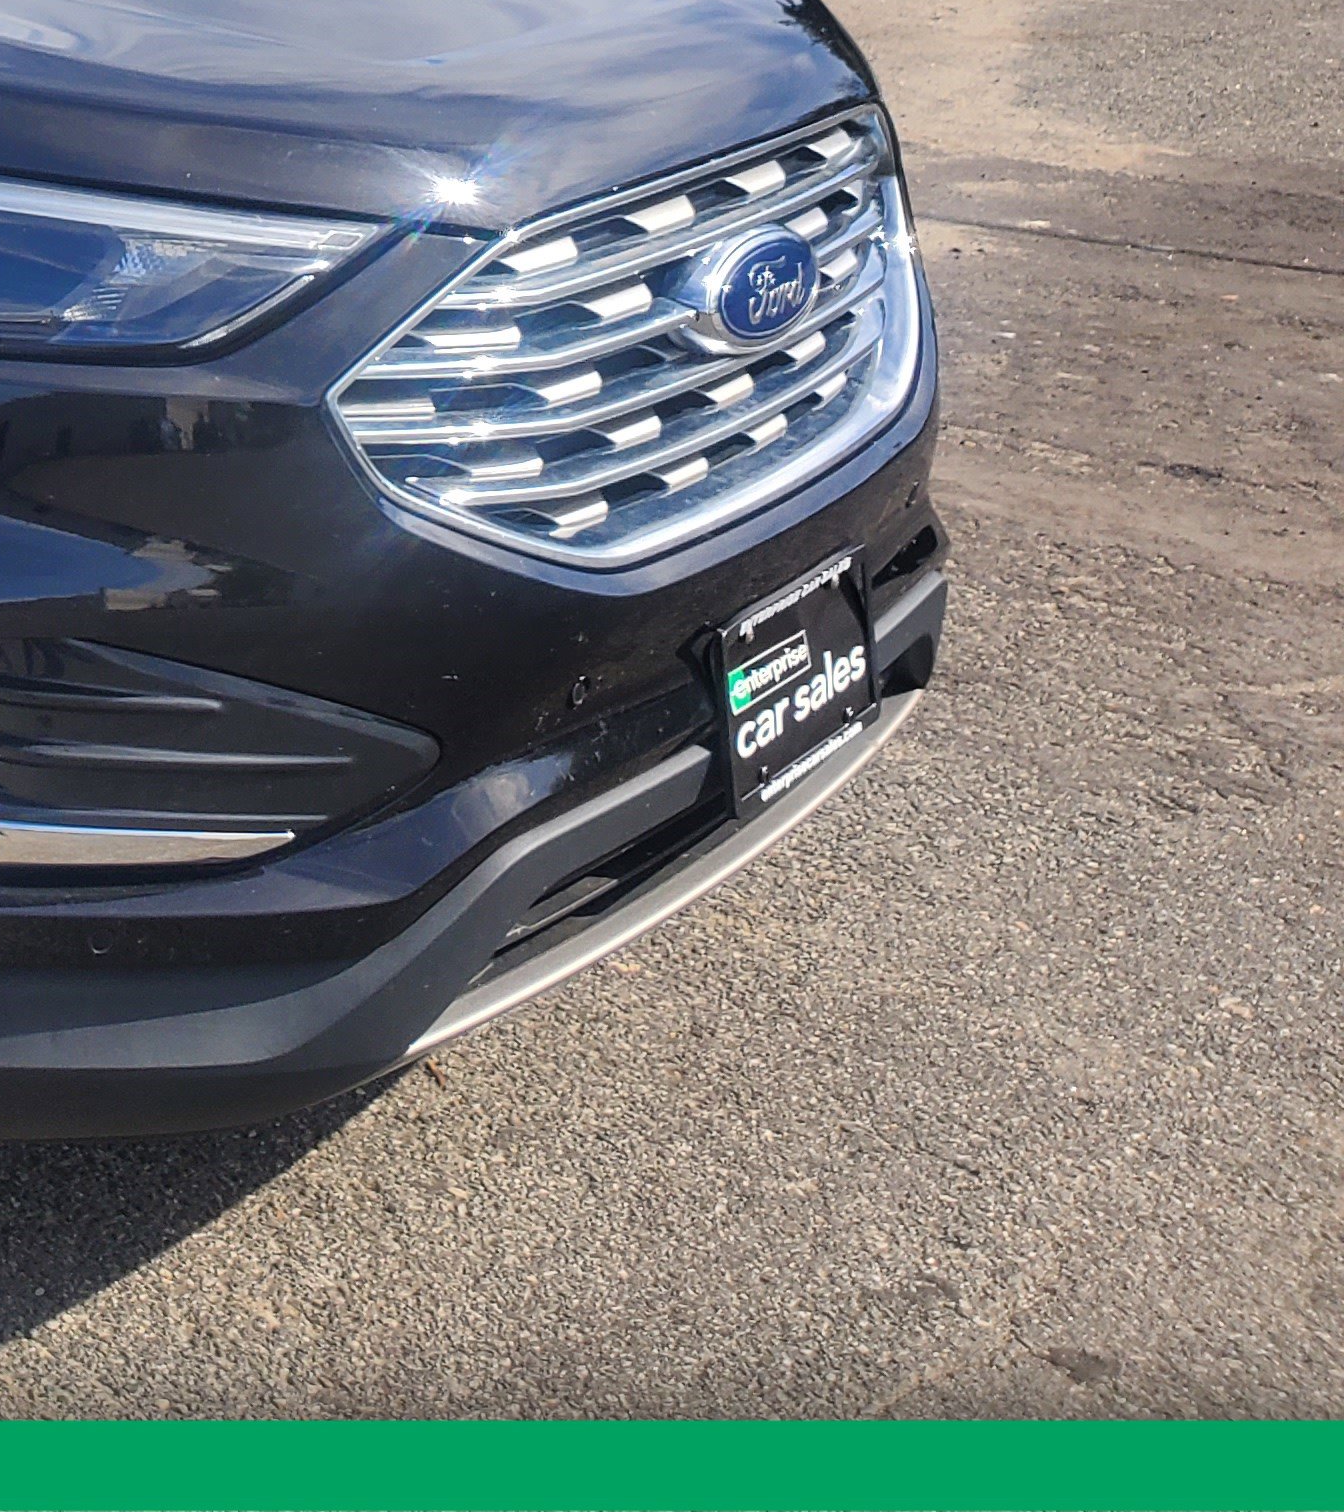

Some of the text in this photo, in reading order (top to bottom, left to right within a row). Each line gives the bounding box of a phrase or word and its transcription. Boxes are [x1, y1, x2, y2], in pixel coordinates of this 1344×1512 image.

[748, 256, 805, 325] Ford
[731, 642, 809, 700] enterprise
[736, 645, 866, 759] car sales
